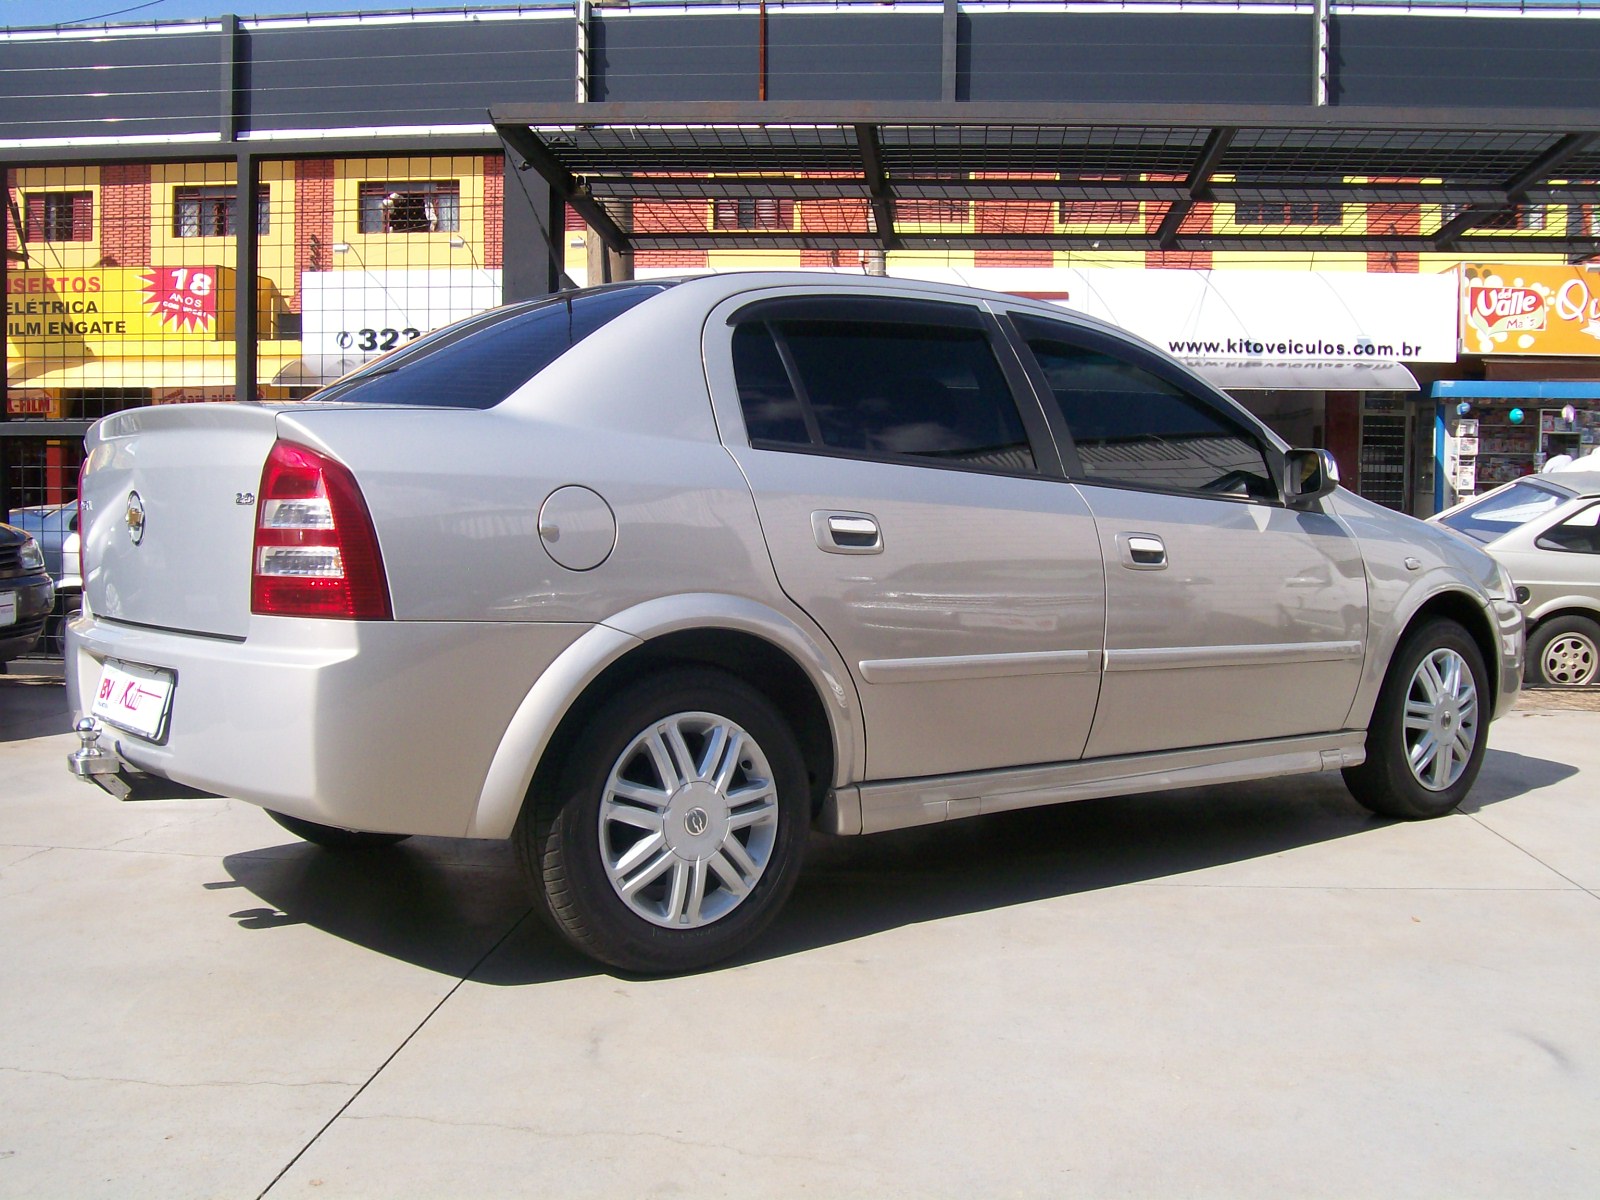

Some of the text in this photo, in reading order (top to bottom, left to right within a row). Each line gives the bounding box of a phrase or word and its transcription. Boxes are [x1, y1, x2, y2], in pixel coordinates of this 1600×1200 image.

[171, 268, 212, 296] 18
[7, 298, 98, 314] ELÉTRICA
[169, 292, 202, 308] ANOS
[1476, 289, 1537, 317] Valle
[48, 320, 126, 335] ENGATE
[1506, 316, 1536, 330] Mas
[1168, 338, 1422, 357] www.kitoveiculos.com.br
